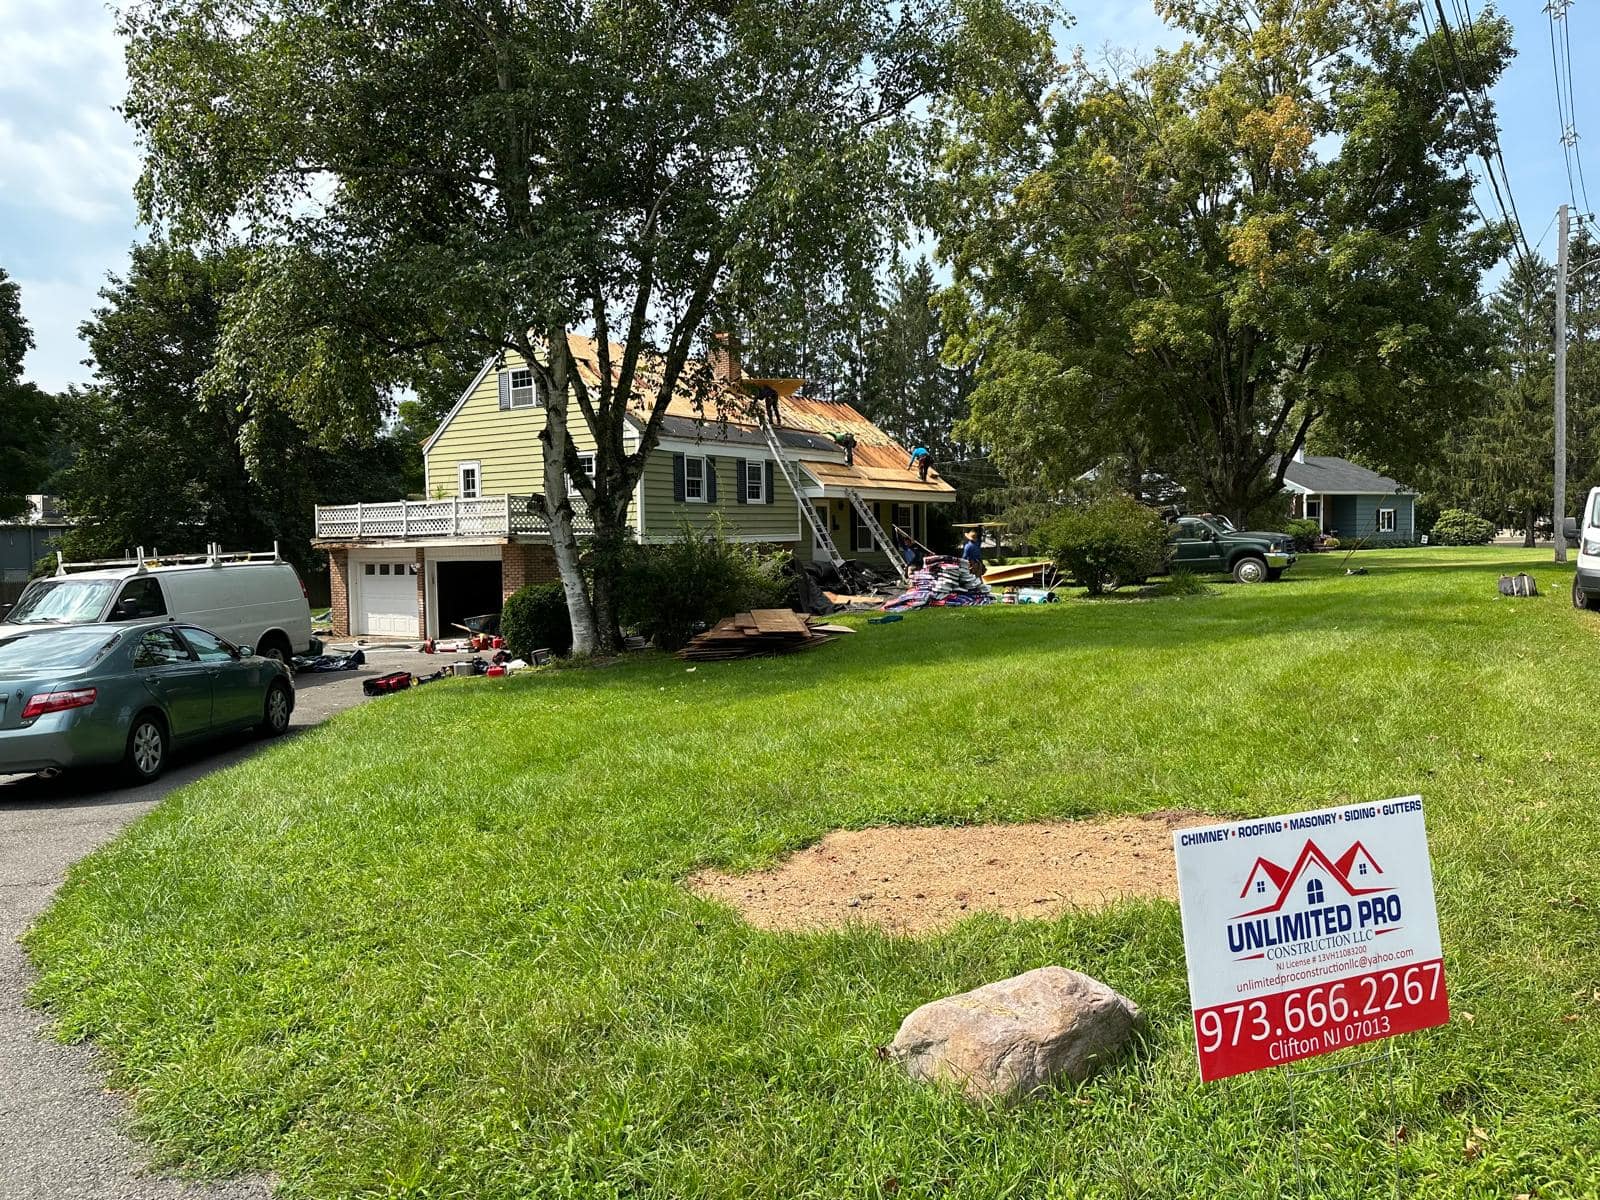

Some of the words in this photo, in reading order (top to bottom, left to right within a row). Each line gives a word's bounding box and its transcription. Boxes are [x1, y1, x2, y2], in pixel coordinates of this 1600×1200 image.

[1181, 829, 1229, 846] CHIMNEY
[1238, 822, 1282, 838] ROOFING
[1289, 813, 1337, 830] MASONRY
[1344, 807, 1375, 821] SIDING
[1382, 800, 1422, 815] GUTTERS
[1227, 904, 1352, 953] UNLIMITED
[1357, 894, 1402, 928] PRO
[1266, 934, 1351, 961] CONSTRUCTION
[1353, 929, 1374, 943] LLC
[1236, 948, 1415, 993] unlimitedproconstructionllc@yahoo.com
[1286, 957, 1312, 968] License
[1200, 963, 1441, 1053] 973.666.2267
[1269, 1036, 1319, 1061] Clifton
[1324, 1030, 1341, 1047] NJ
[1344, 1015, 1391, 1042] 07013
